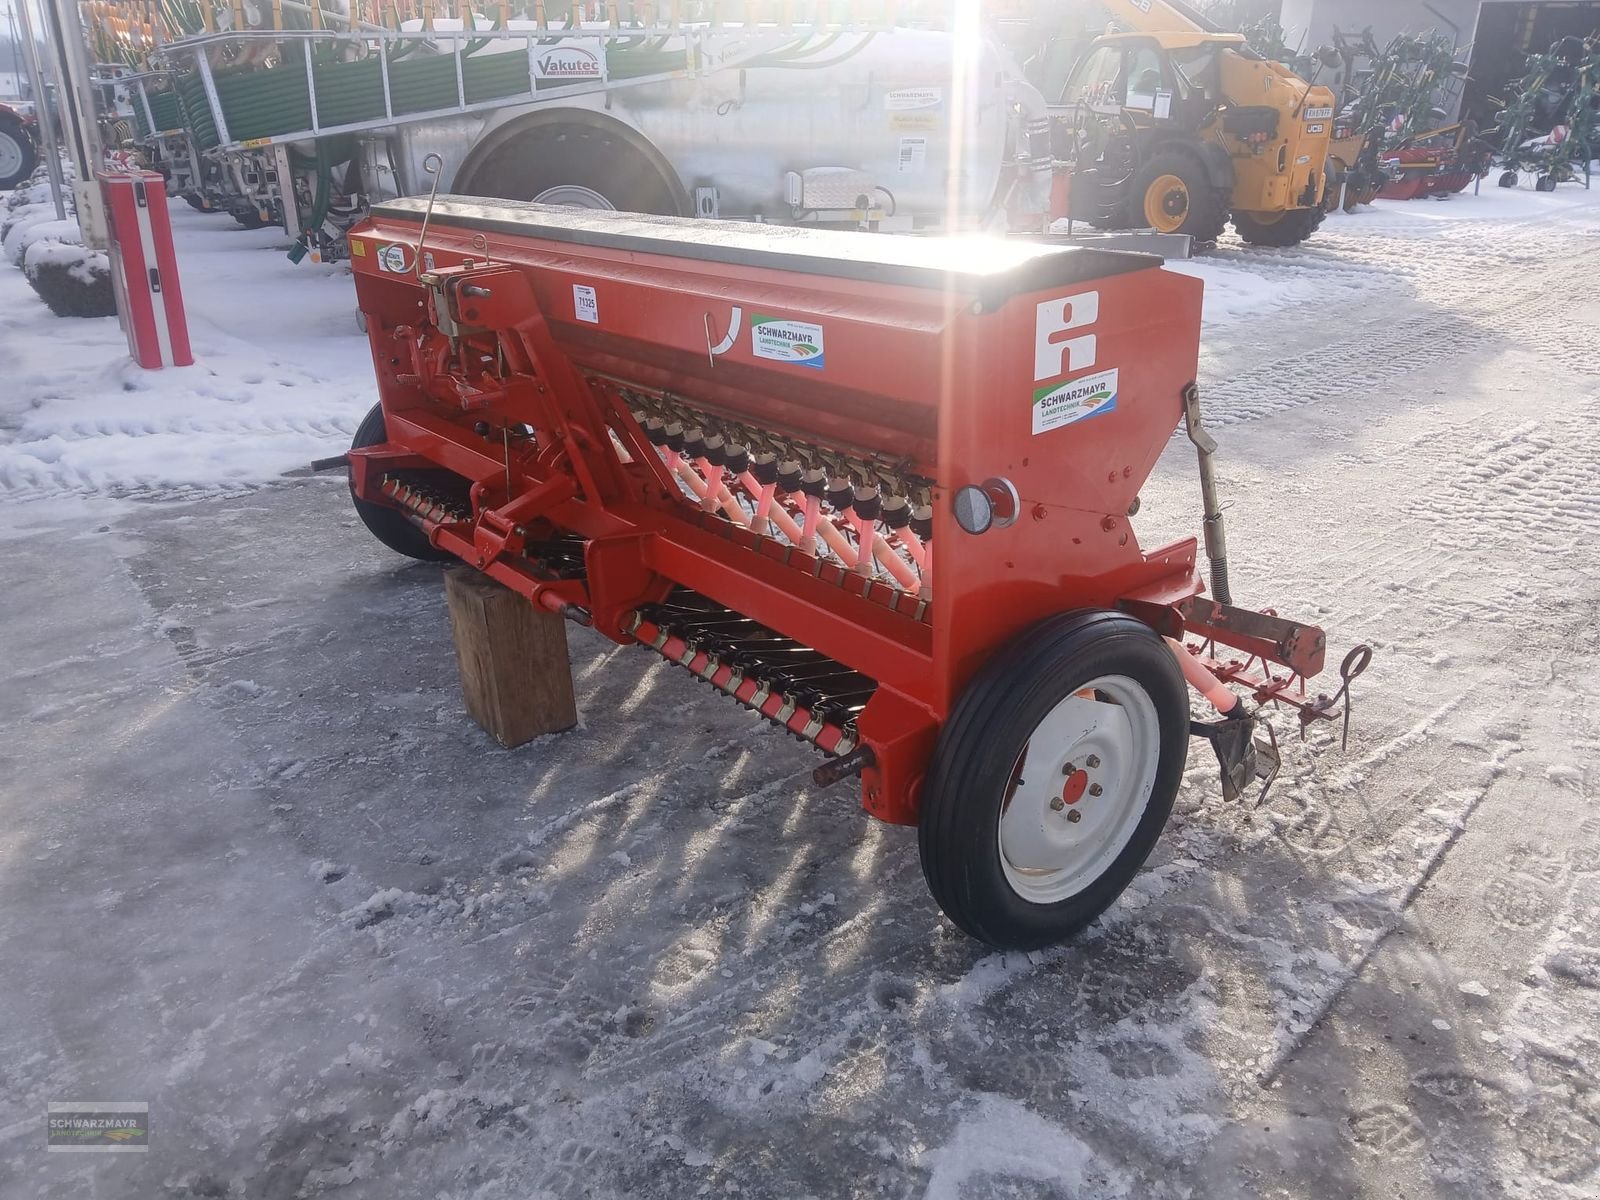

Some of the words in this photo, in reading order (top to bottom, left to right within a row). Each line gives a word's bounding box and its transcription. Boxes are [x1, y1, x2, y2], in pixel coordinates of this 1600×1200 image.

[537, 56, 599, 75] Vakutec
[1307, 125, 1323, 133] JCB
[579, 296, 595, 308] 71325
[758, 325, 813, 344] SCHWARZMAYR
[760, 338, 790, 348] LANDTECHNIK
[1041, 382, 1106, 408] SCHWARZMAYR
[1042, 401, 1080, 417] LANDTECHNIK
